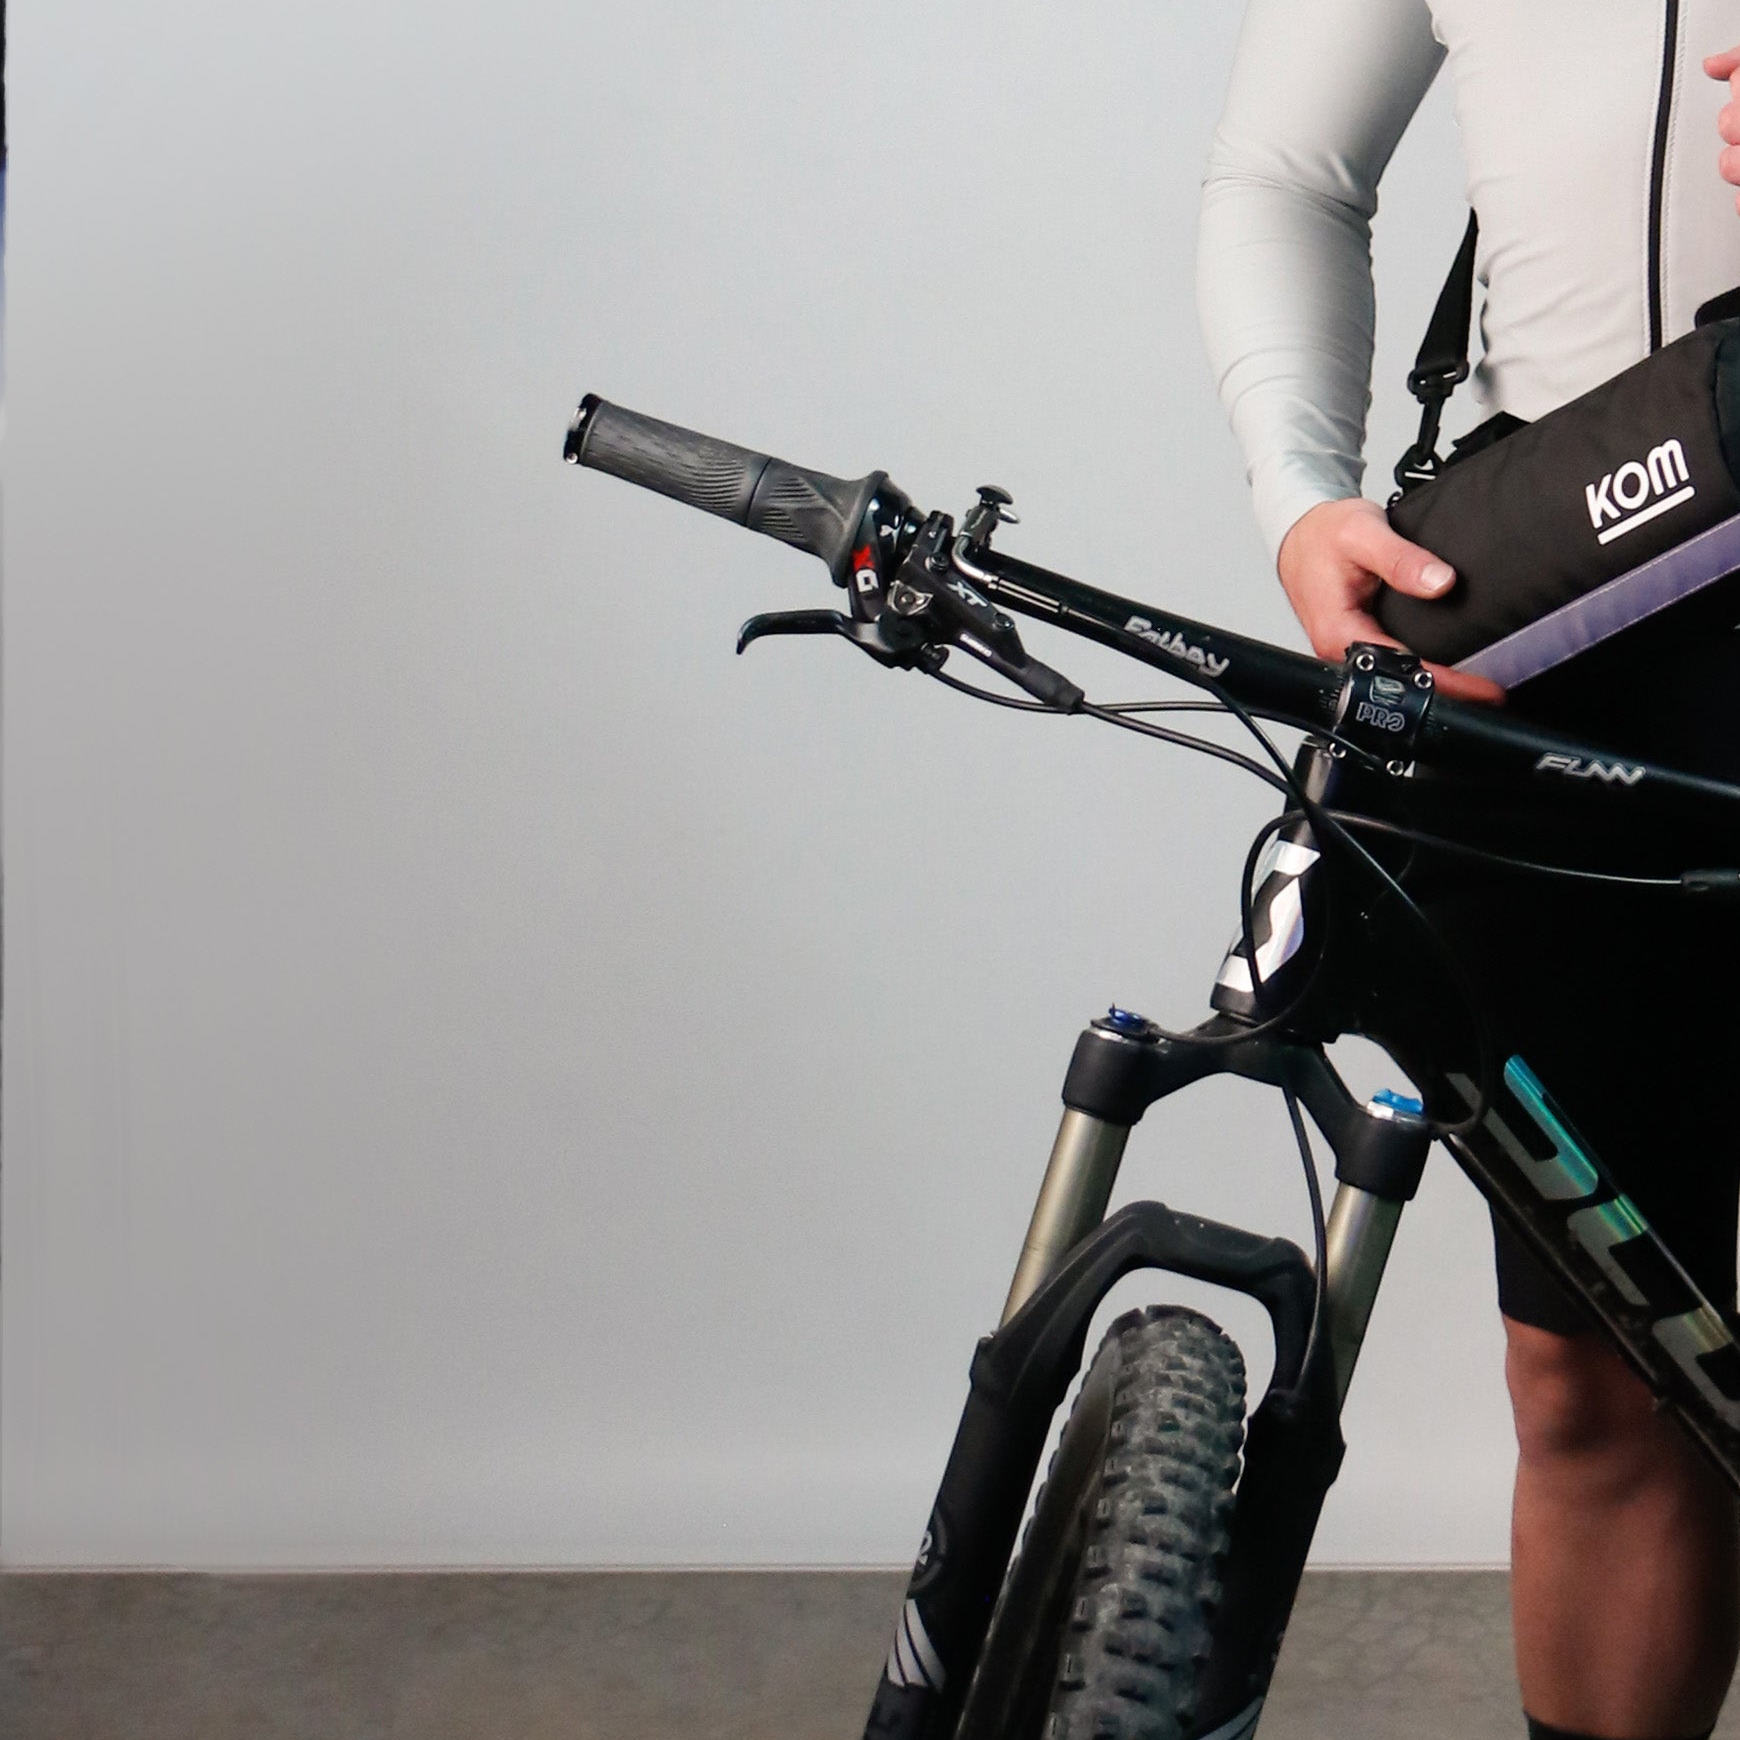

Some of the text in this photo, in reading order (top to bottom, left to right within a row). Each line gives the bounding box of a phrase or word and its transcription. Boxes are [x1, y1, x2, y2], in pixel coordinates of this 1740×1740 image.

[1585, 439, 1690, 529] KOM
[948, 582, 988, 608] XT
[1356, 701, 1406, 732] PRO
